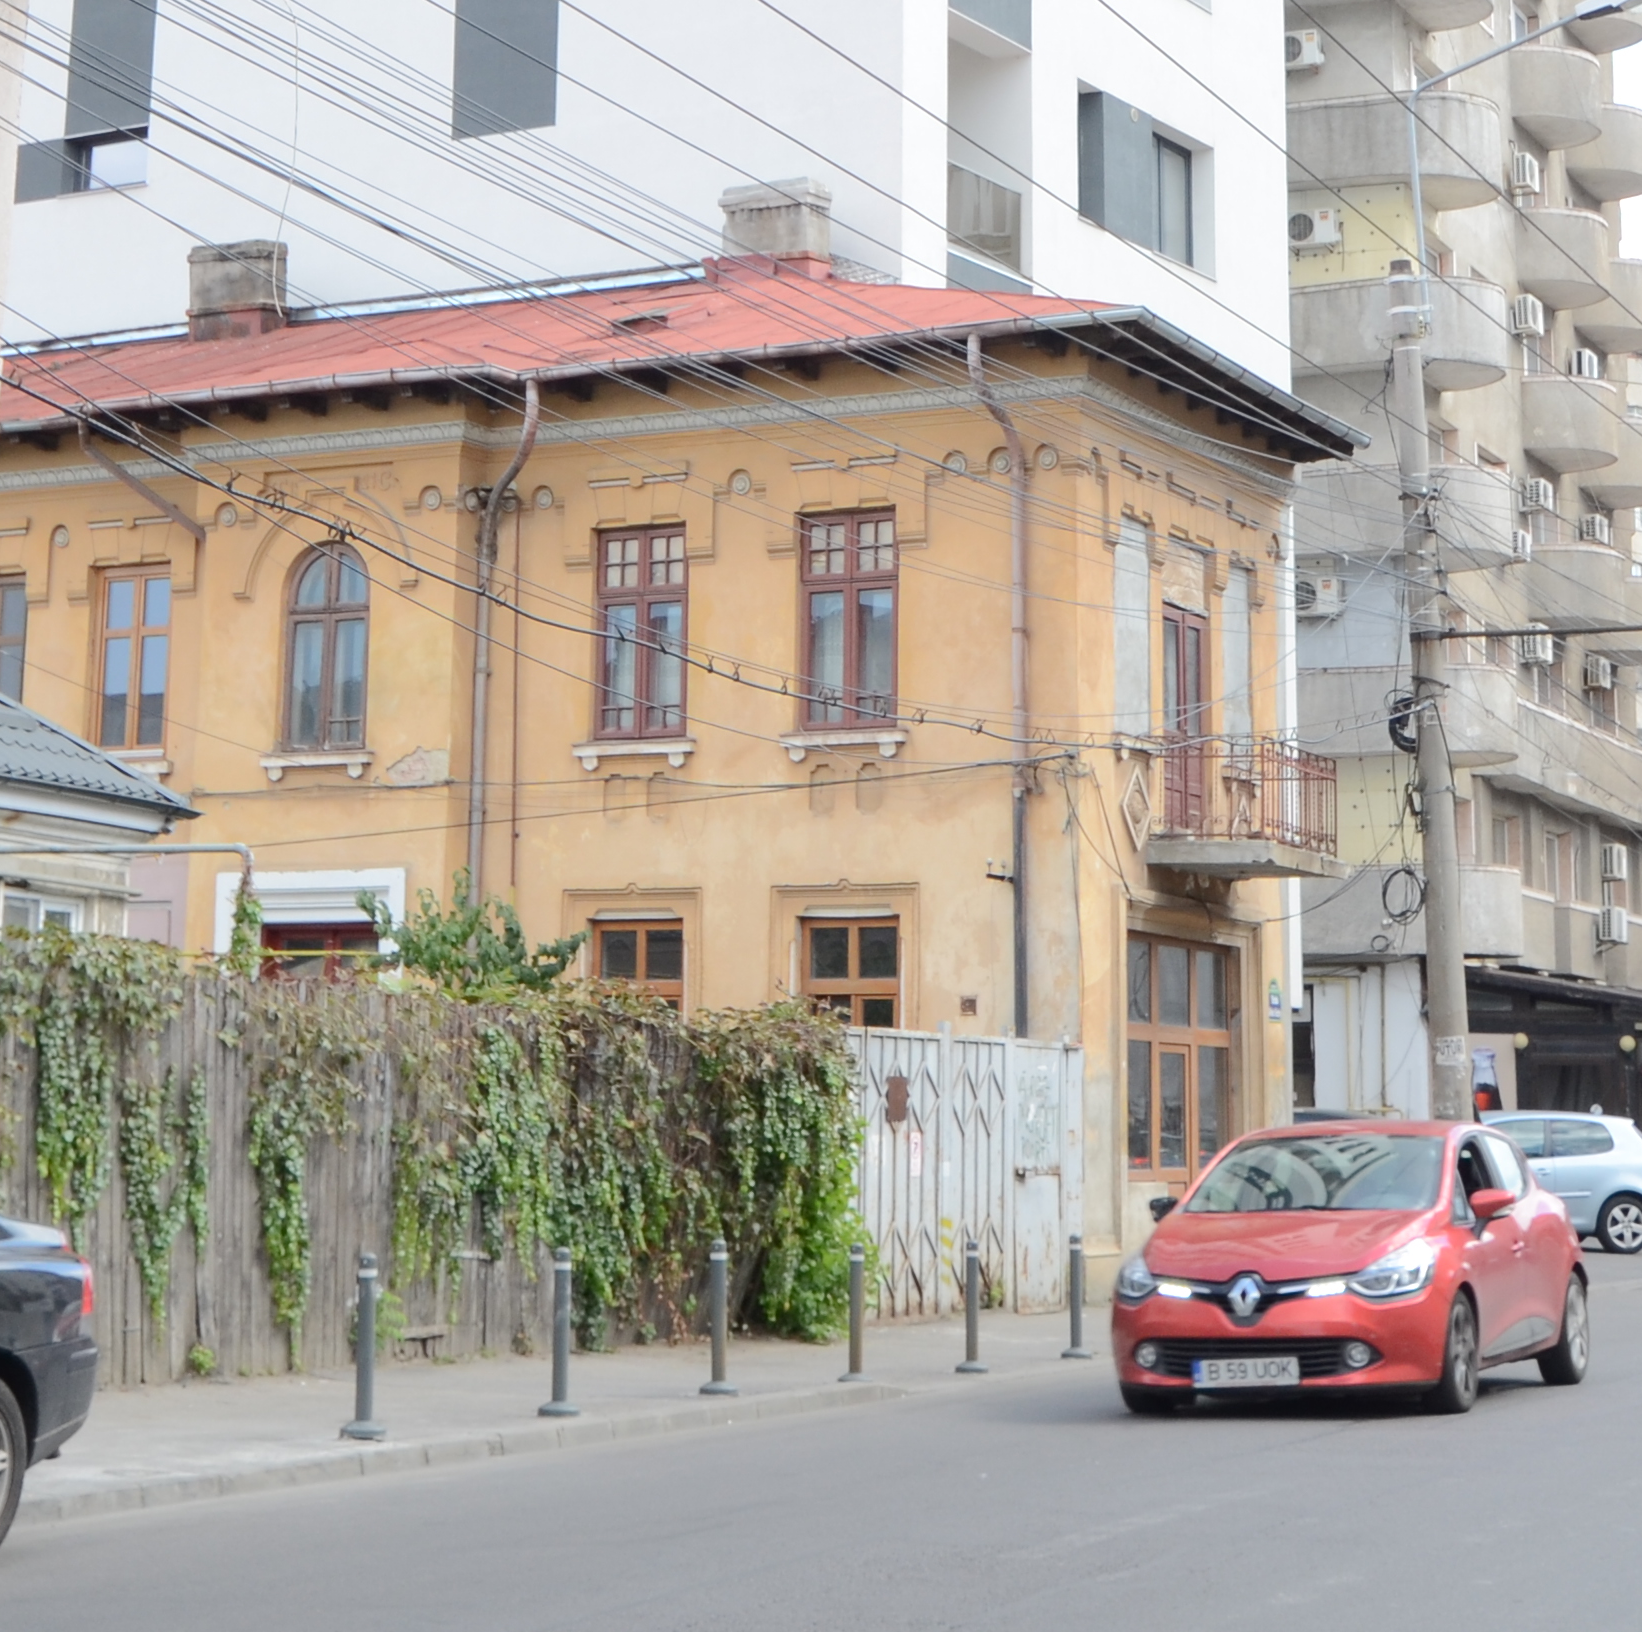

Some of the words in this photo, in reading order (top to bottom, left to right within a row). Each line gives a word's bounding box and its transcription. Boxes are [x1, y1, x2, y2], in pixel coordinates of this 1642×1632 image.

[1207, 1363, 1220, 1381] B
[1226, 1362, 1248, 1380] 59
[1254, 1359, 1294, 1379] UOK
